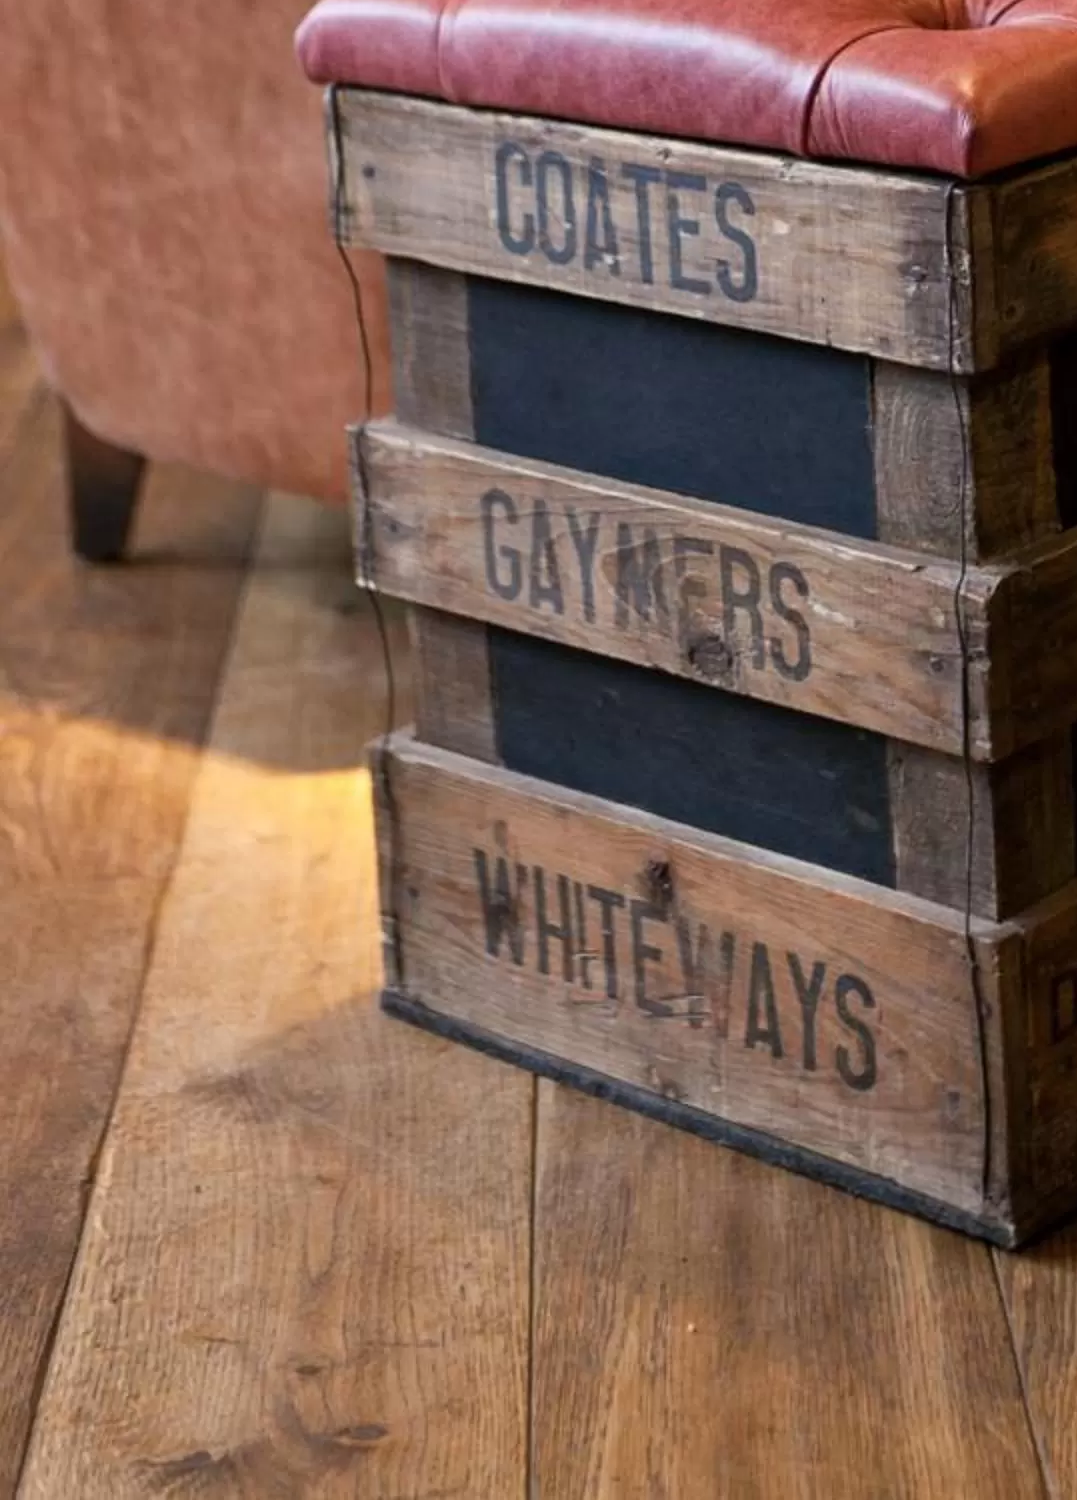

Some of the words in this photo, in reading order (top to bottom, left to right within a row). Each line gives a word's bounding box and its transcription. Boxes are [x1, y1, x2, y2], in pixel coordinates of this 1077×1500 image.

[495, 140, 758, 303] COATES
[479, 487, 812, 682] GAYMERS
[473, 843, 878, 1092] WHITEWAYS
